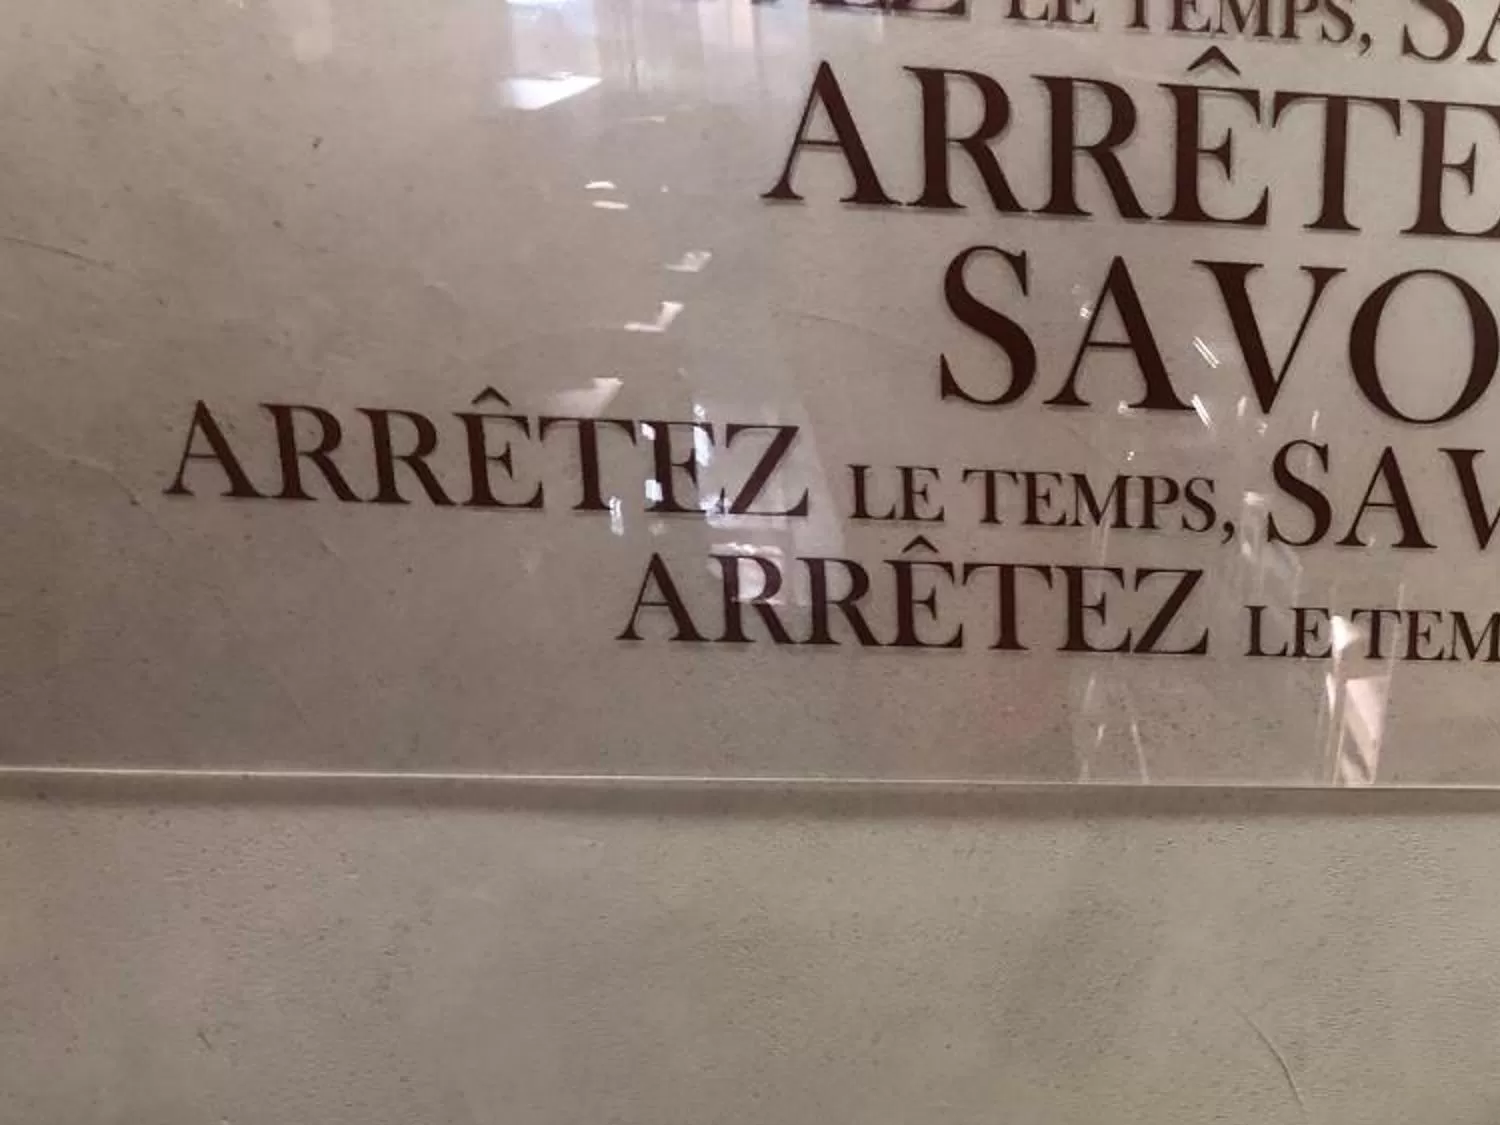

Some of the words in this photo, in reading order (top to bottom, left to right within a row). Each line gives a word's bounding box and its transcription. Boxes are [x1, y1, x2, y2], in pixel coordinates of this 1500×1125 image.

[163, 386, 811, 518] ARRÊTEZ
[846, 462, 945, 523] LE
[963, 466, 1237, 546] TEMPS,
[616, 535, 1212, 657] ARRÊTEZ
[1243, 604, 1332, 660] LE
